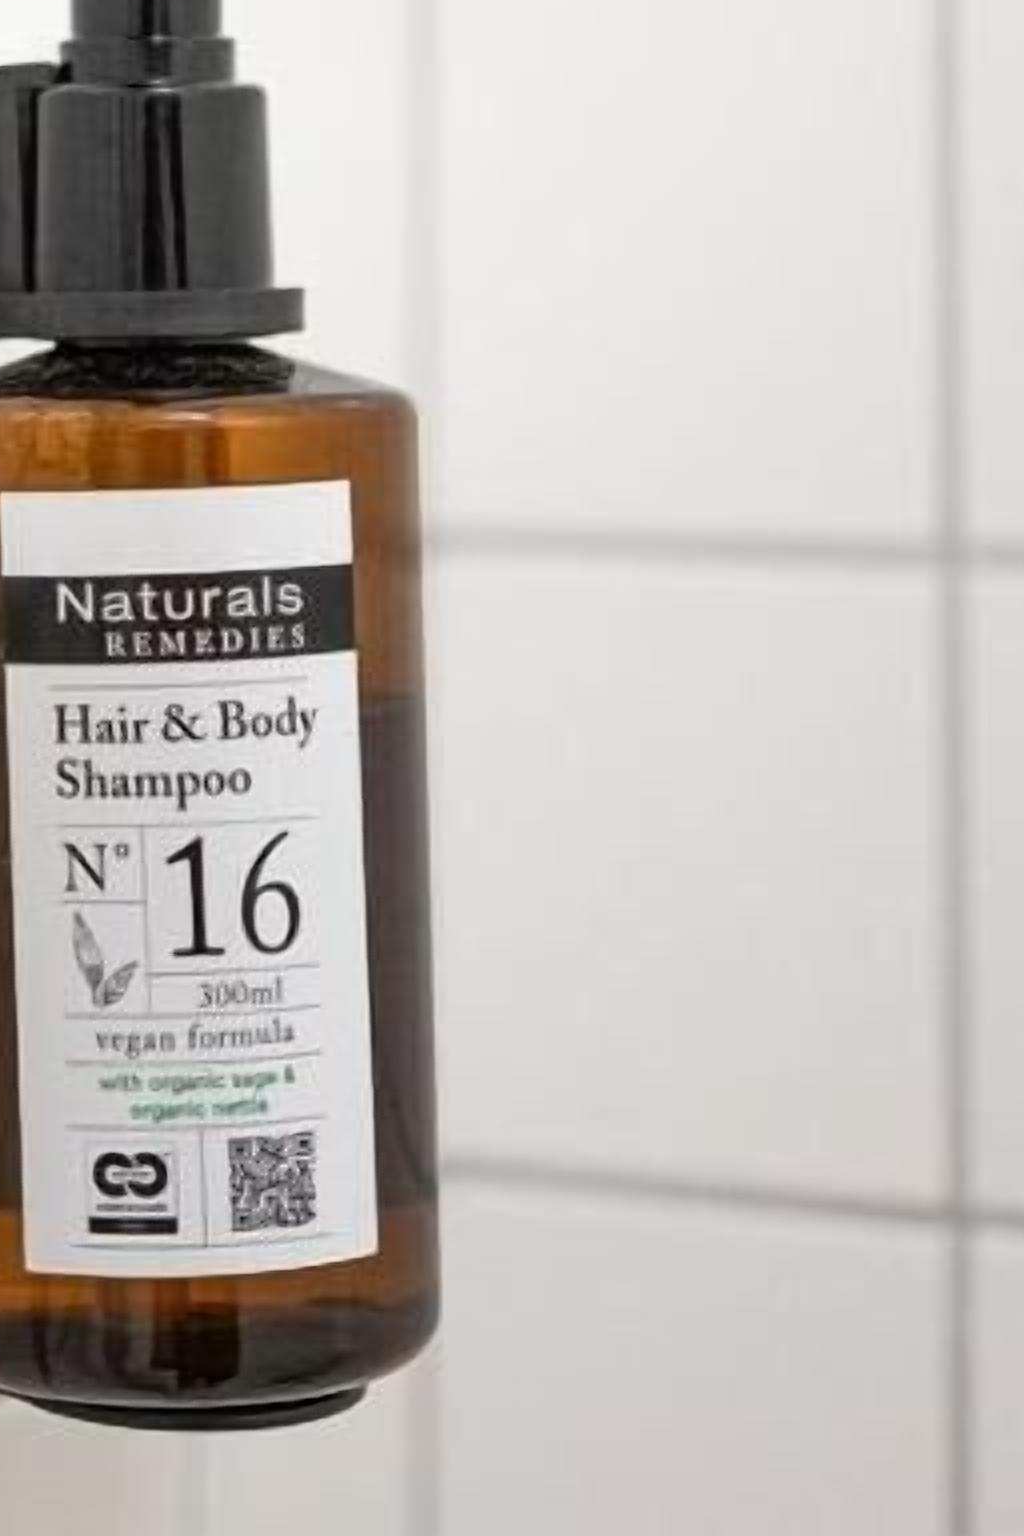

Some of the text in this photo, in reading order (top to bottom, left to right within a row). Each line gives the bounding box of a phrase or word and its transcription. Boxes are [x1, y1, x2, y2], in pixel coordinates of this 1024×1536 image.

[56, 576, 305, 623] Naturals
[106, 623, 306, 657] REMEDIES
[54, 696, 319, 748] Hair & Body
[55, 758, 252, 811] Shampoo
[166, 830, 301, 957] 16
[198, 977, 284, 1008] 300ml
[95, 1017, 295, 1059] vegan formula
